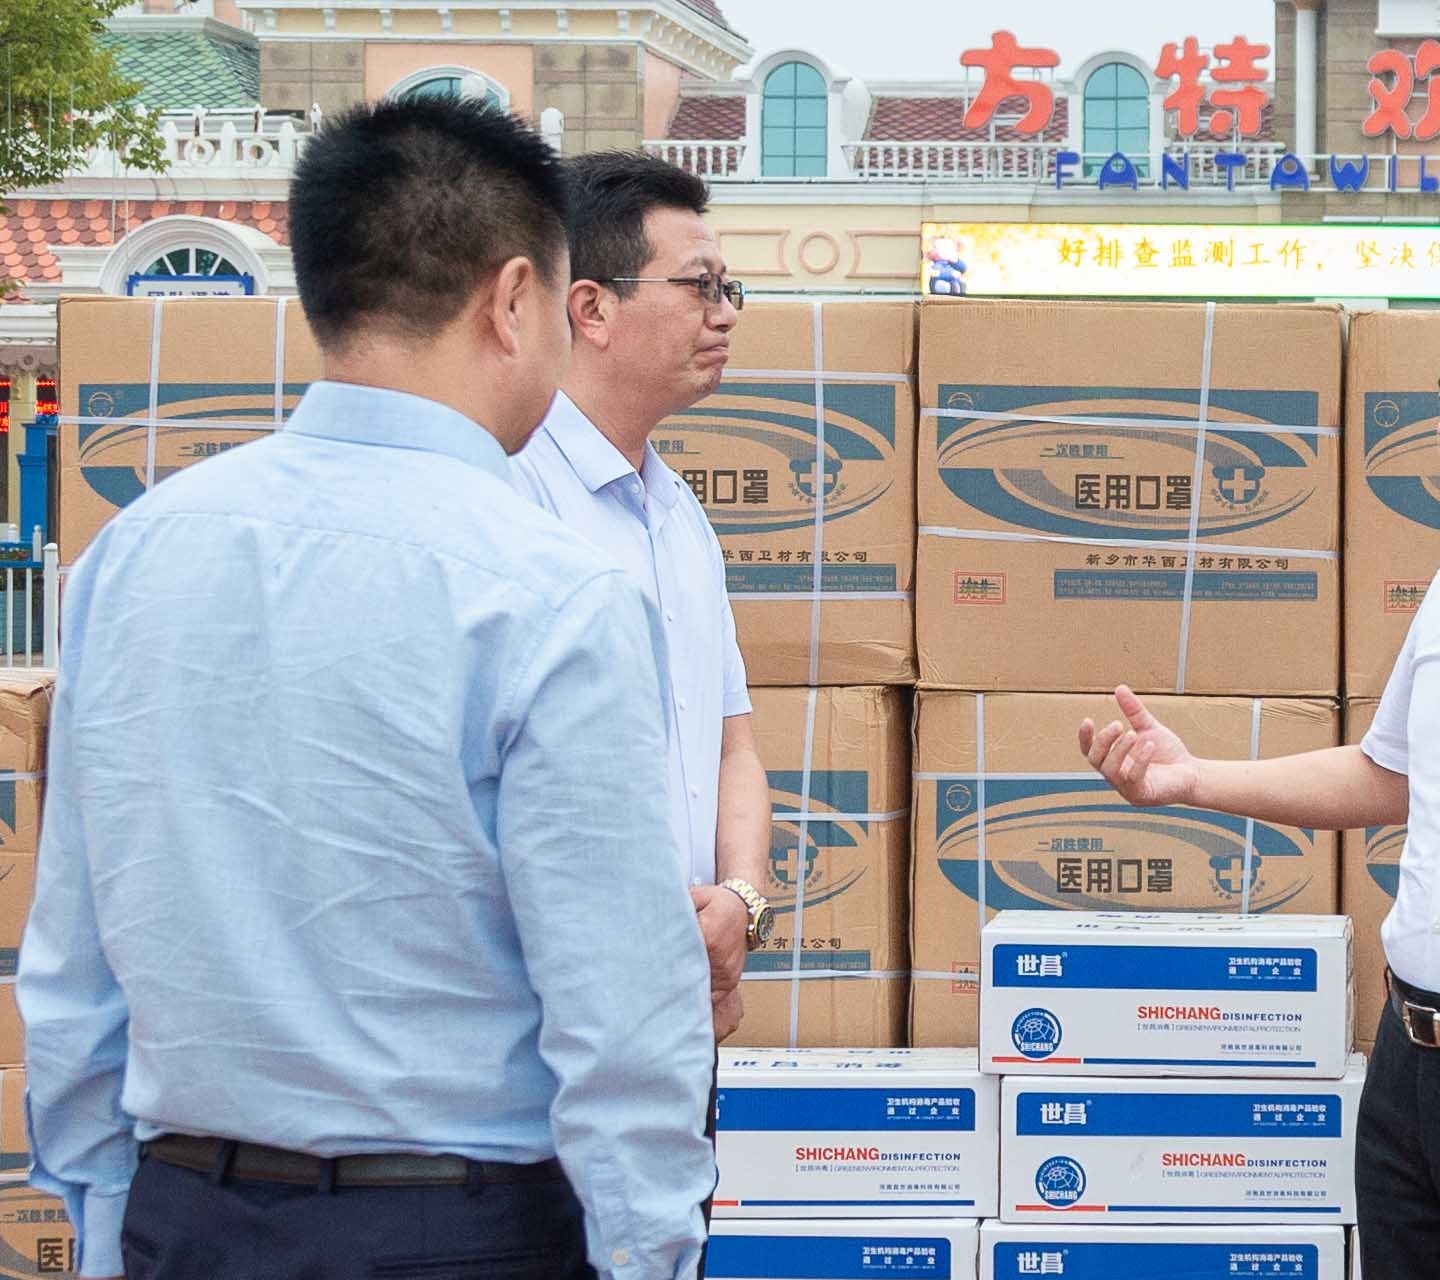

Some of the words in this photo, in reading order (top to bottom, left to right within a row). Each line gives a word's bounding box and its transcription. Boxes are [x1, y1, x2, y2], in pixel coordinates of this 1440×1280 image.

[672, 469, 769, 505] 用口罩
[1075, 473, 1192, 511] 医用口罩
[1056, 857, 1174, 894] 医用口罩
[1016, 953, 1064, 977] 世昌
[1137, 1006, 1221, 1020] SHICHANG
[1222, 1012, 1302, 1022] DISINFECTION
[1039, 1102, 1087, 1126] 世昌
[795, 1147, 880, 1161] SHICHANG
[880, 1152, 961, 1161] DISINFECTION
[1162, 1153, 1246, 1167] SHICHANG
[1247, 1159, 1327, 1168] DISINFECTION
[37, 1237, 77, 1273] 医
[1016, 1252, 1064, 1274] 世昌
